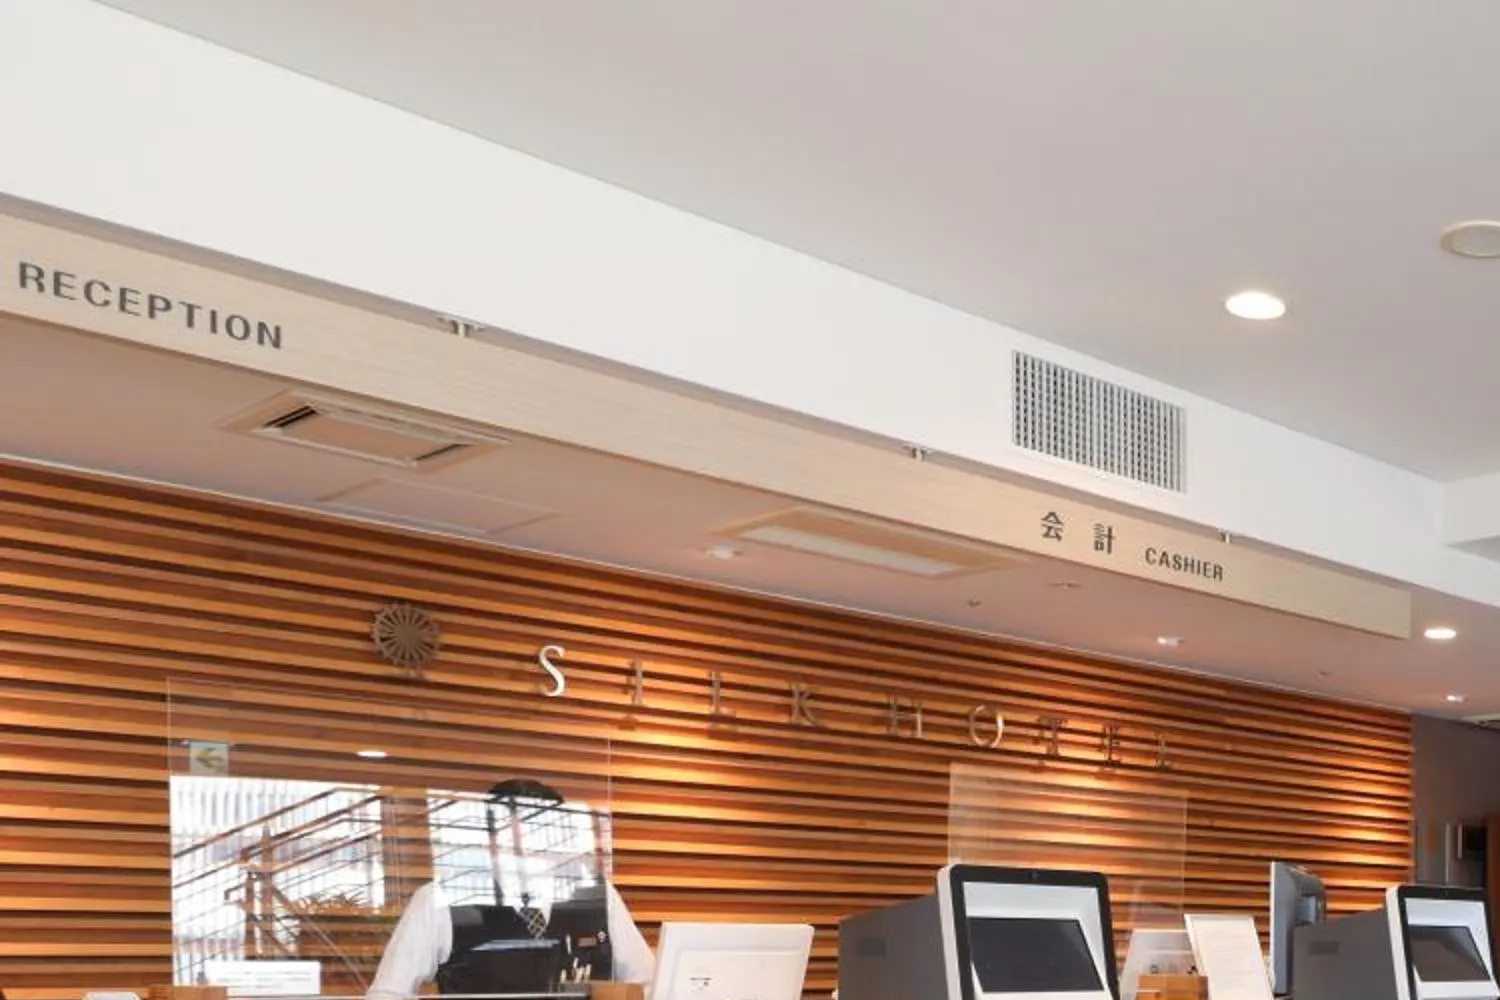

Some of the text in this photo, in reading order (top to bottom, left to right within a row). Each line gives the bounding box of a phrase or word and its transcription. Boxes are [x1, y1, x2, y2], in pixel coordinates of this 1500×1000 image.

[18, 261, 282, 349] RECEPTION
[1145, 547, 1223, 581] CASHIER
[538, 645, 1174, 770] SILK HOTEL
